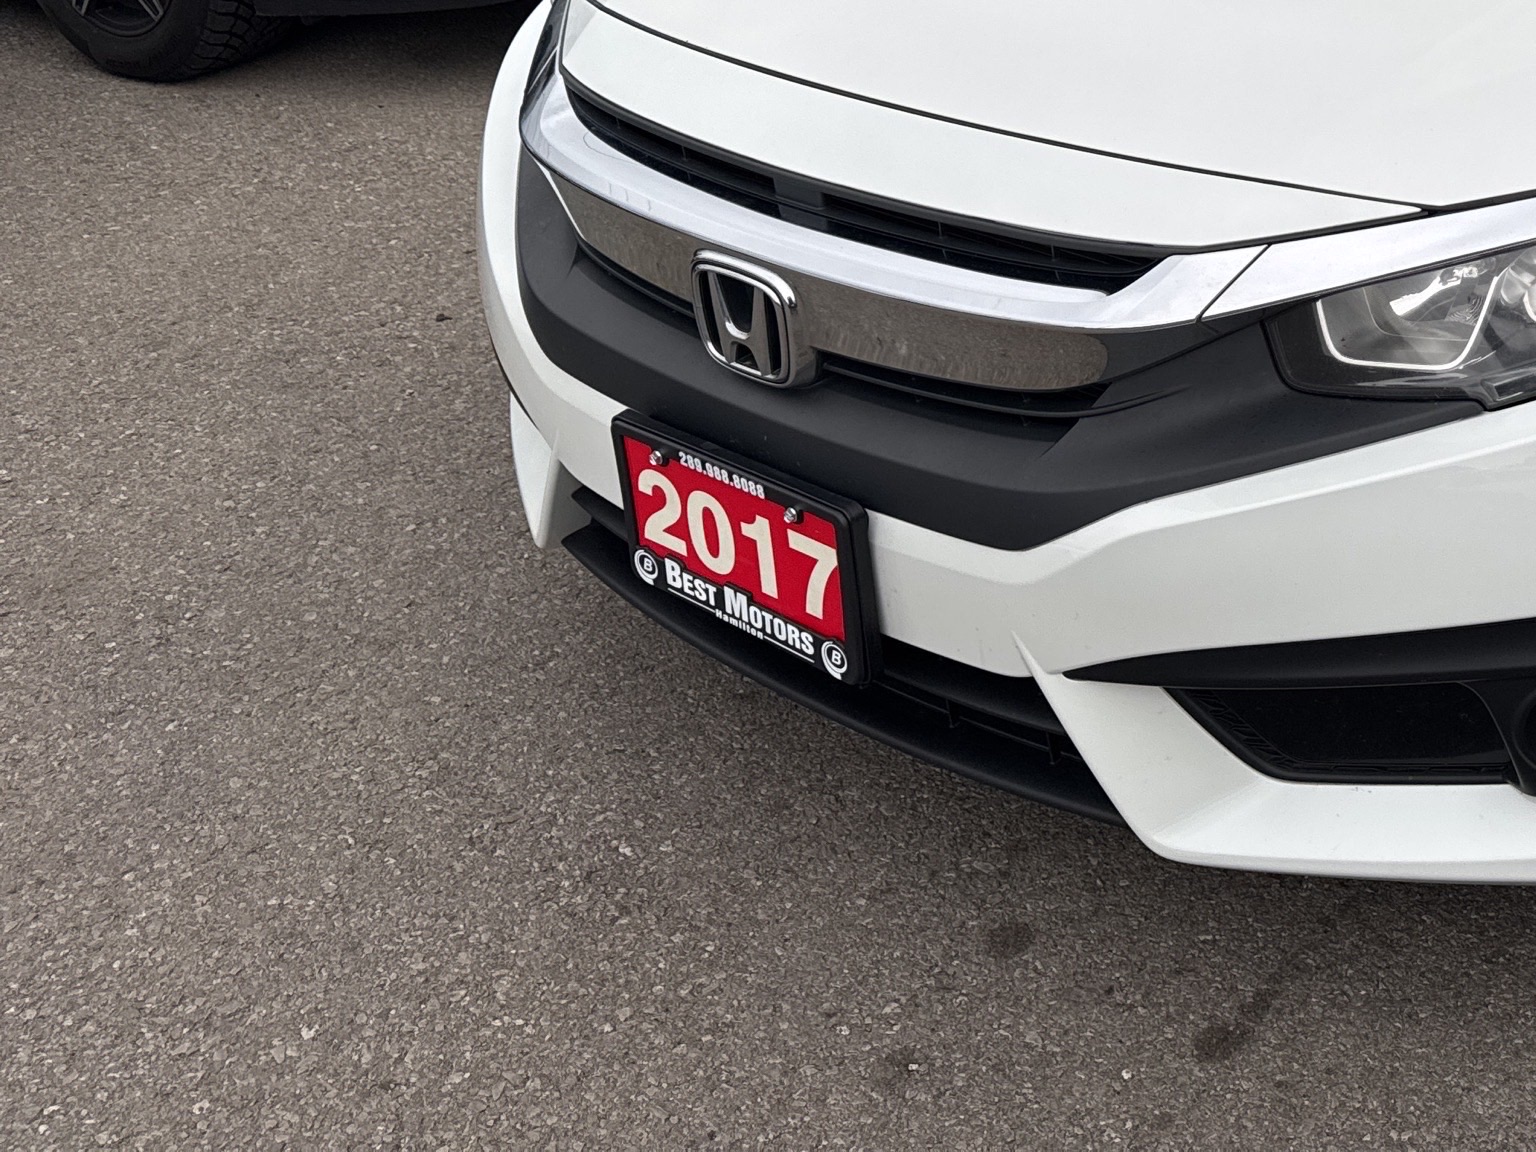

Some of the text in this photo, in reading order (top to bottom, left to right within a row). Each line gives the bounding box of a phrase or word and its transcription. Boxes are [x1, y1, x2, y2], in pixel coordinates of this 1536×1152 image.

[678, 451, 766, 500] 289.988.8088
[637, 468, 838, 620] 2017
[664, 557, 815, 656] BEST MOTORS
[715, 608, 764, 640] Hamilton
